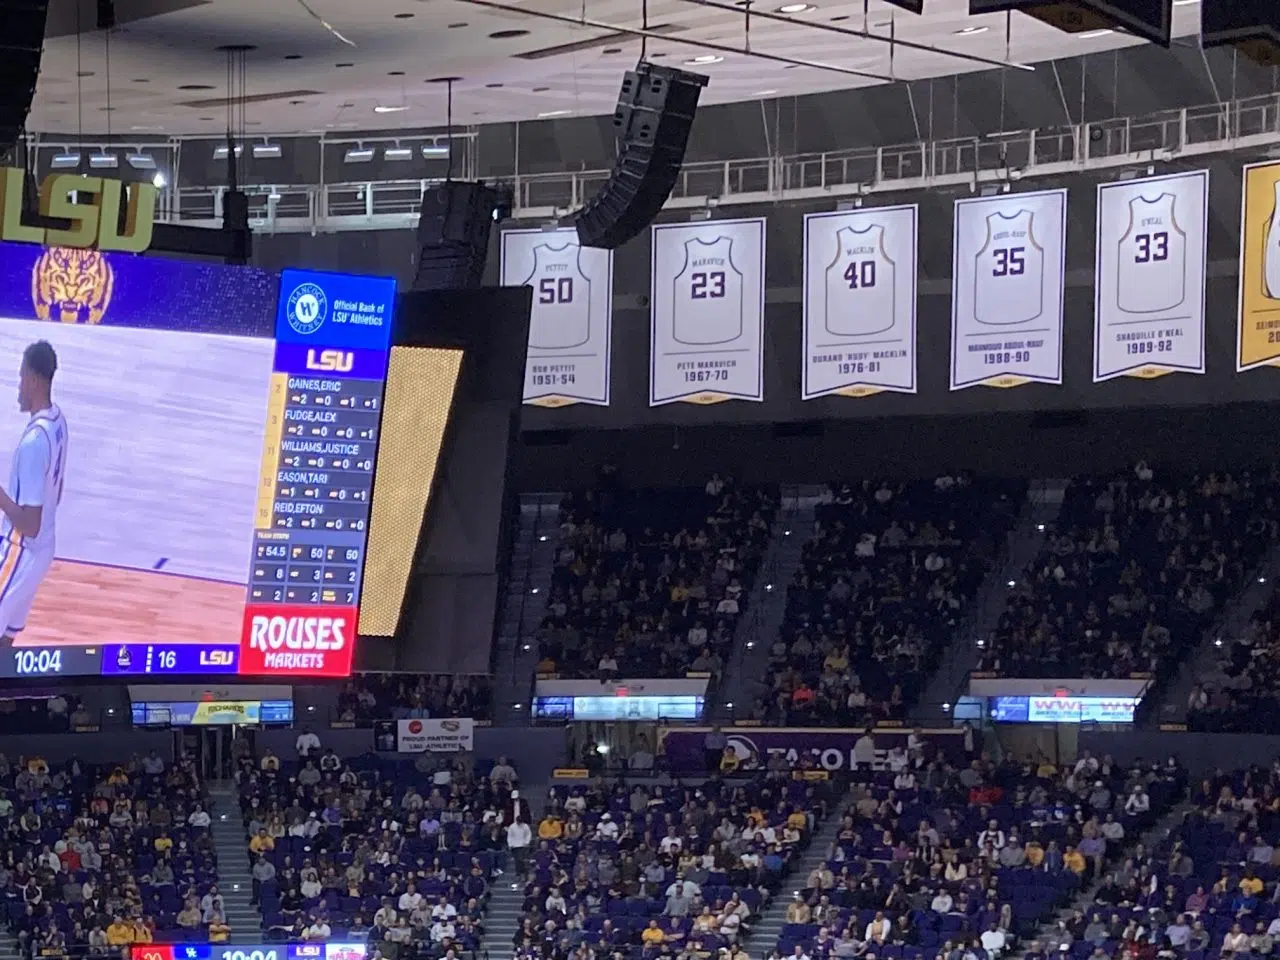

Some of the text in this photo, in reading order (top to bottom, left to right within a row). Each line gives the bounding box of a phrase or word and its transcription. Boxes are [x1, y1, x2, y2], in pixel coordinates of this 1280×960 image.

[1134, 231, 1169, 263] 33
[992, 247, 1026, 277] 35
[844, 260, 876, 289] 40
[539, 277, 574, 304] 50
[691, 271, 726, 299] 23
[1157, 328, 1184, 339] O'NEAL
[1126, 340, 1173, 355] 1989-92
[306, 349, 354, 372] LSU
[698, 360, 737, 370] MARAVICH
[984, 351, 1030, 365] 1988-90
[532, 374, 576, 386] 1951-54
[684, 369, 729, 382] 1967-70
[250, 615, 345, 652] ROUSES
[14, 650, 62, 674] 10:04
[158, 651, 176, 669] 16
[200, 650, 234, 666] LSU
[264, 652, 324, 669] MARKETS
[296, 945, 320, 956] LSU
